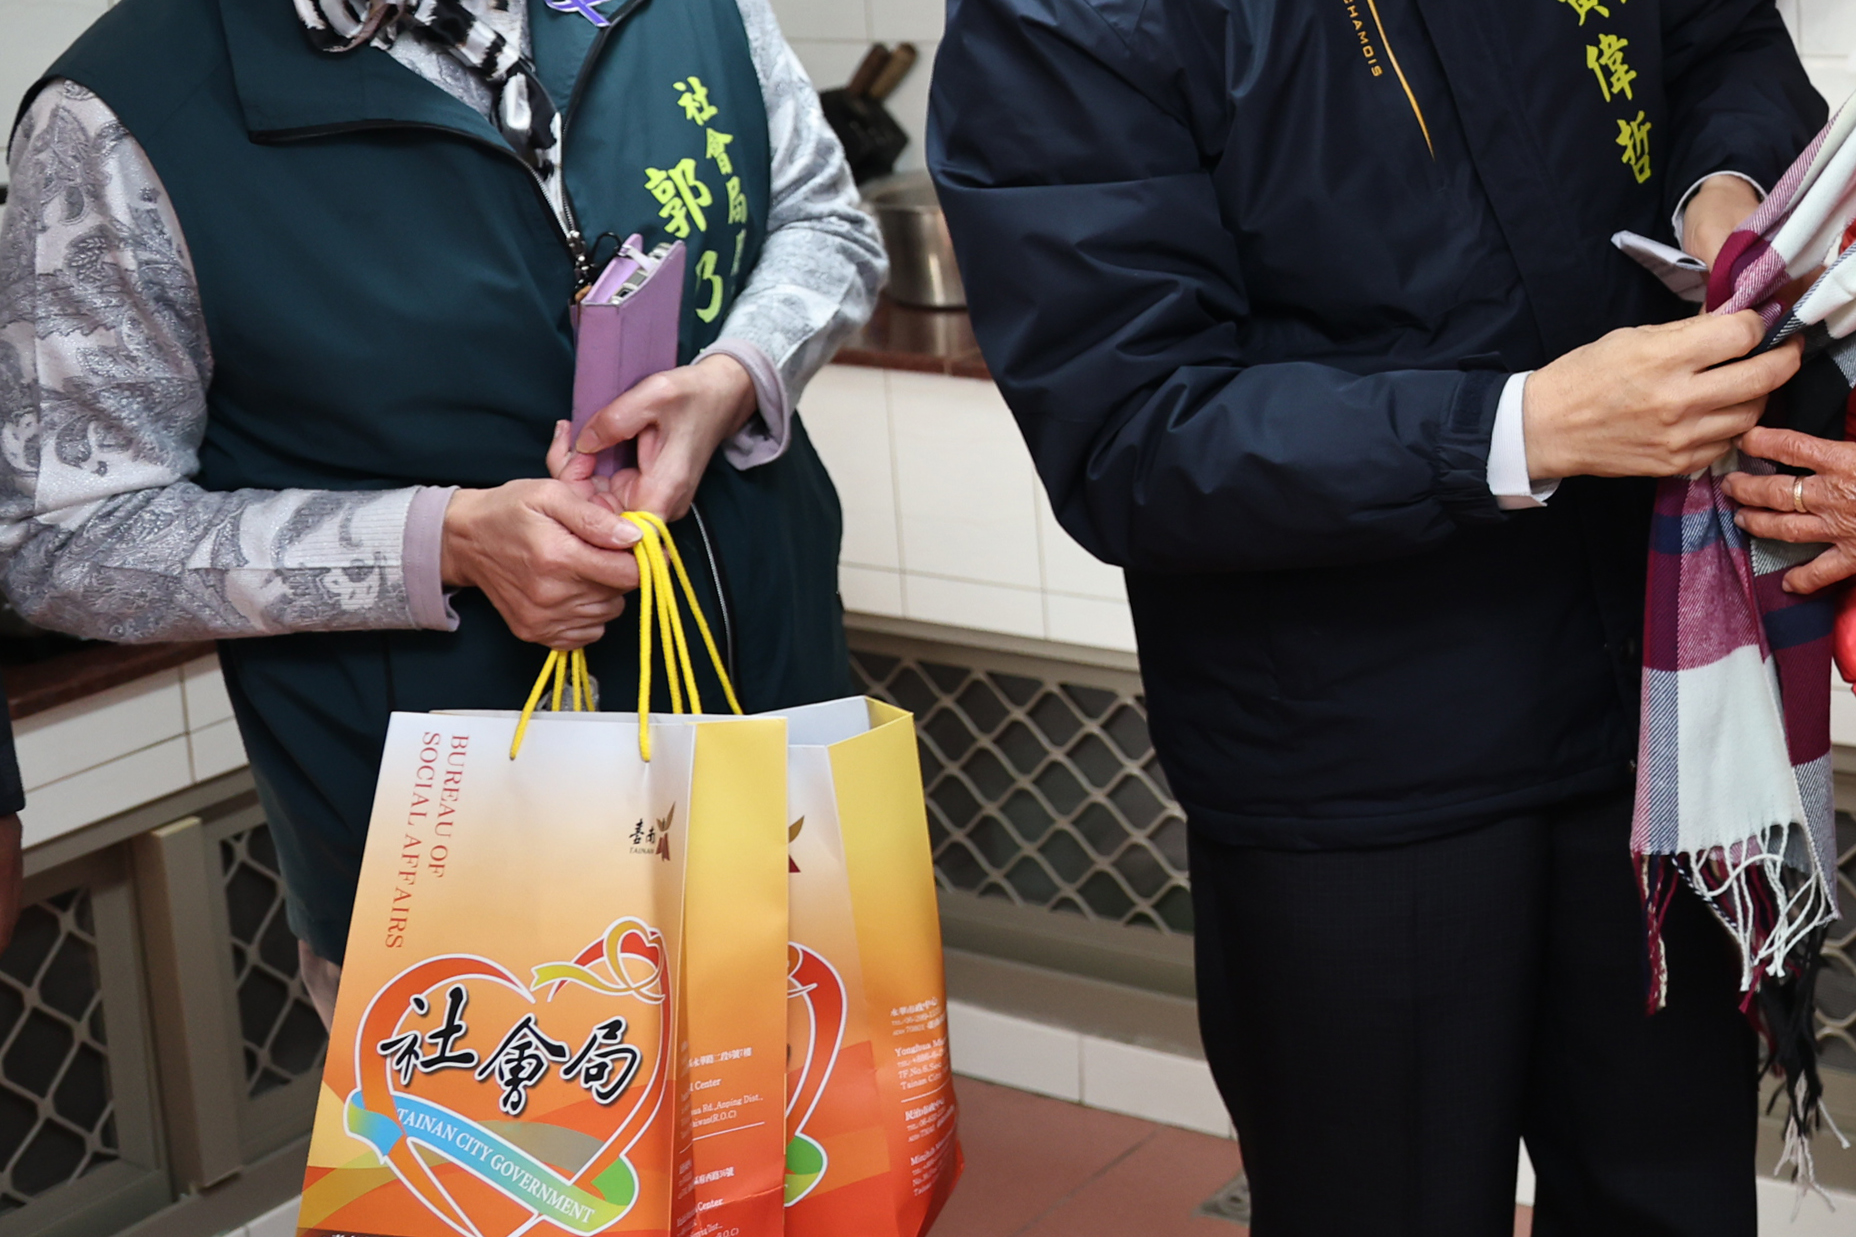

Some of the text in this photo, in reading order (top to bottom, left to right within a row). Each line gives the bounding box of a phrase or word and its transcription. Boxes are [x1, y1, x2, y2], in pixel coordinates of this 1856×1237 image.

[645, 158, 723, 325] 郭乃
[385, 731, 441, 949] SOCIAL AFFAIRS
[428, 735, 469, 878] BUREAU OF
[376, 983, 642, 1115] 社會局
[694, 1078, 721, 1091] Center
[397, 1107, 596, 1224] TAINAN CITY GOVERNMENT
